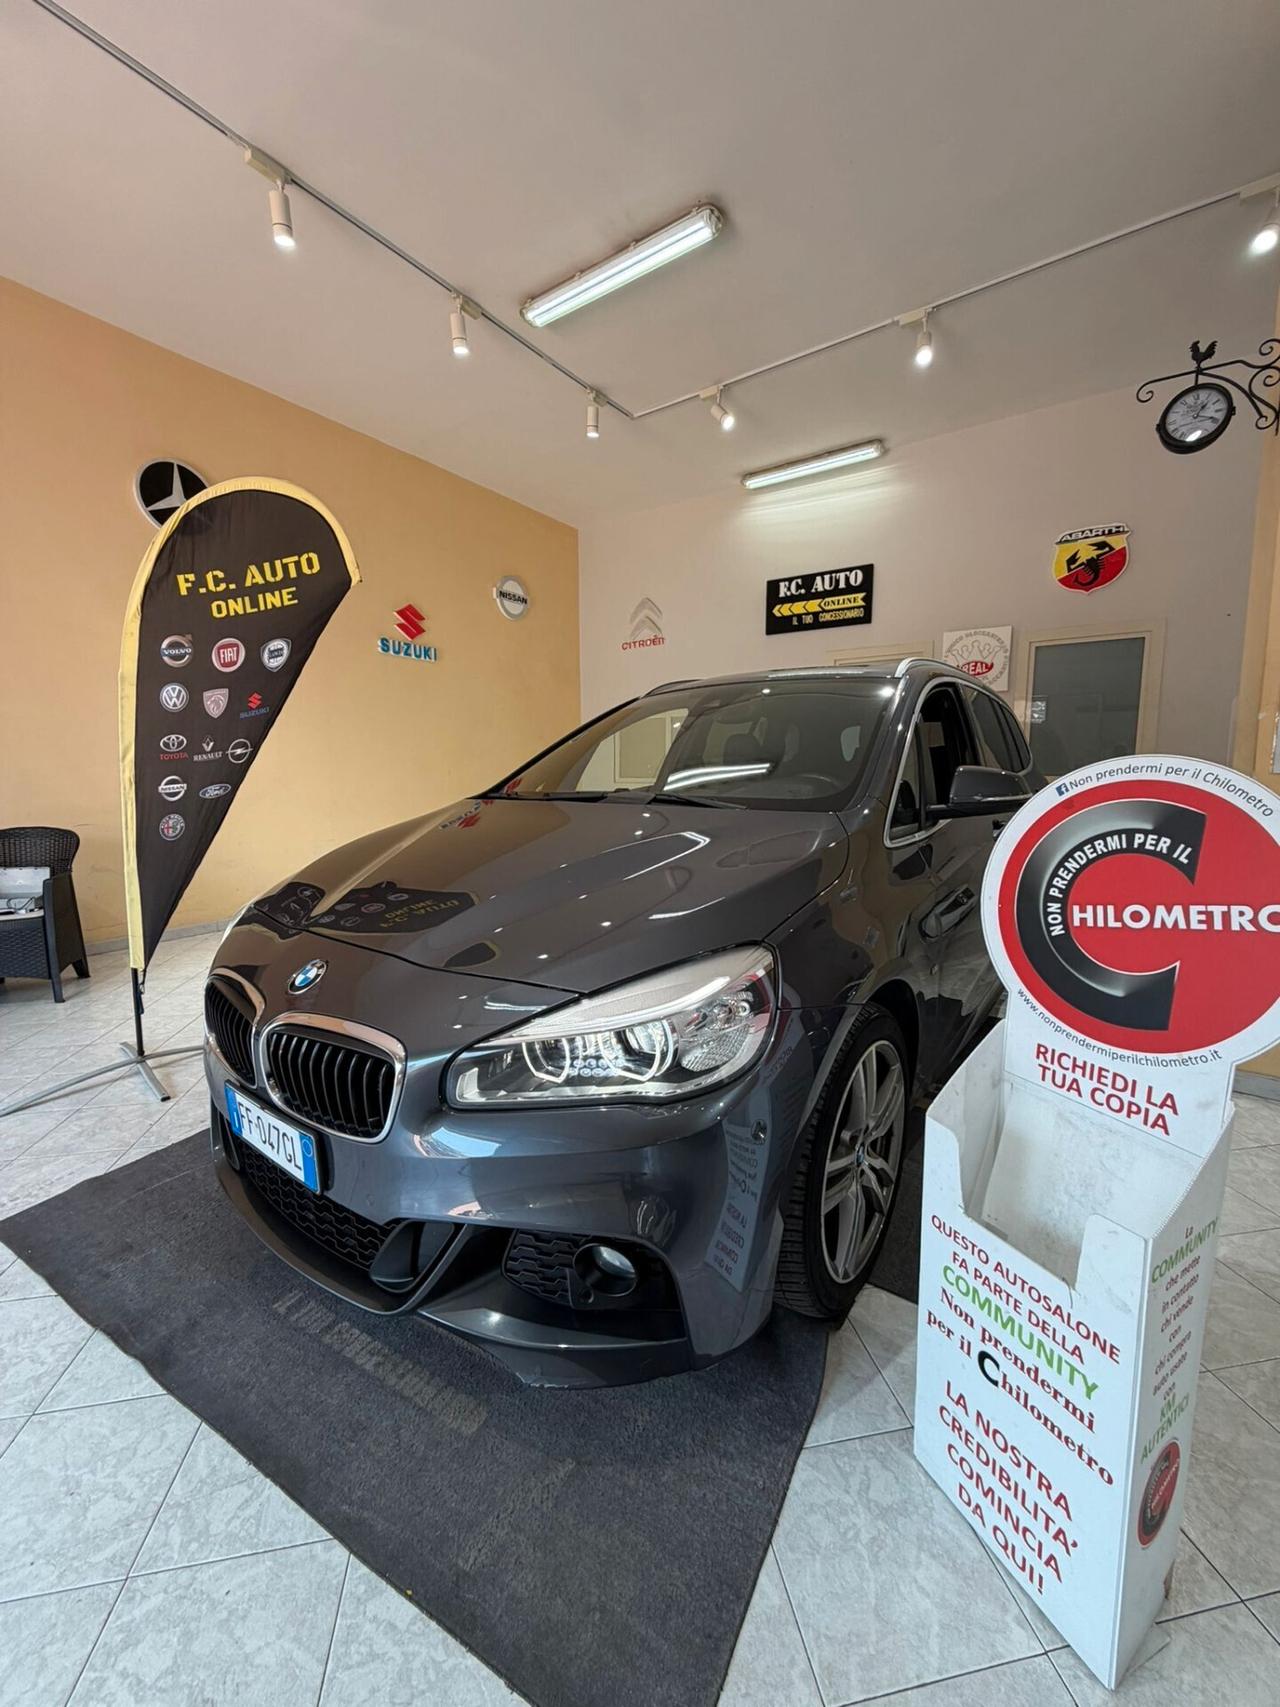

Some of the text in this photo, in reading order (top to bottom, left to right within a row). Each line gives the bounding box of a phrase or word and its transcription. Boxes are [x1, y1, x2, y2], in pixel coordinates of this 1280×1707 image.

[1061, 527, 1124, 542] ABARTH
[176, 552, 321, 596] F.C. AUTO
[498, 590, 528, 605] NISSAN
[778, 569, 864, 598] F.C. AUTO
[210, 586, 299, 618] ONLINE
[823, 596, 860, 608] ONLINE
[162, 647, 192, 655] VOLVO
[219, 647, 238, 664] FIAT
[379, 637, 437, 662] SUZUKI
[962, 662, 989, 675] REAL
[240, 706, 270, 719] SUZUKI
[160, 752, 189, 760] TOYOTA
[193, 751, 223, 762] RENAULT
[1070, 775, 1093, 790] Non
[1096, 763, 1164, 782] prendermi
[1165, 764, 1188, 776] per
[1192, 768, 1202, 780] il
[1203, 772, 1274, 817] Chilometro
[1046, 833, 1193, 937] NON PRENDERMI PER IL
[1017, 988, 1223, 1068] www.nonprendermiperilchilometro.it
[1035, 1042, 1179, 1116] RICHIEDI LA
[1038, 1063, 1170, 1136] TUA COPIA
[1151, 1216, 1219, 1284] COMMUNITY
[931, 1214, 1120, 1365] QUESTO AUTOSALONE
[952, 1251, 1084, 1365] FA PARTE DELLA
[943, 1265, 1099, 1400] COMMUNITY
[940, 1286, 1096, 1434] Non prendermi
[926, 1309, 955, 1341] per
[959, 1335, 973, 1359] il
[977, 1350, 1114, 1486] Chilometro
[946, 1380, 1073, 1522] LA NOSTRA
[947, 1443, 1063, 1584] COMINCIA
[958, 1481, 1044, 1595] DA QUI!
